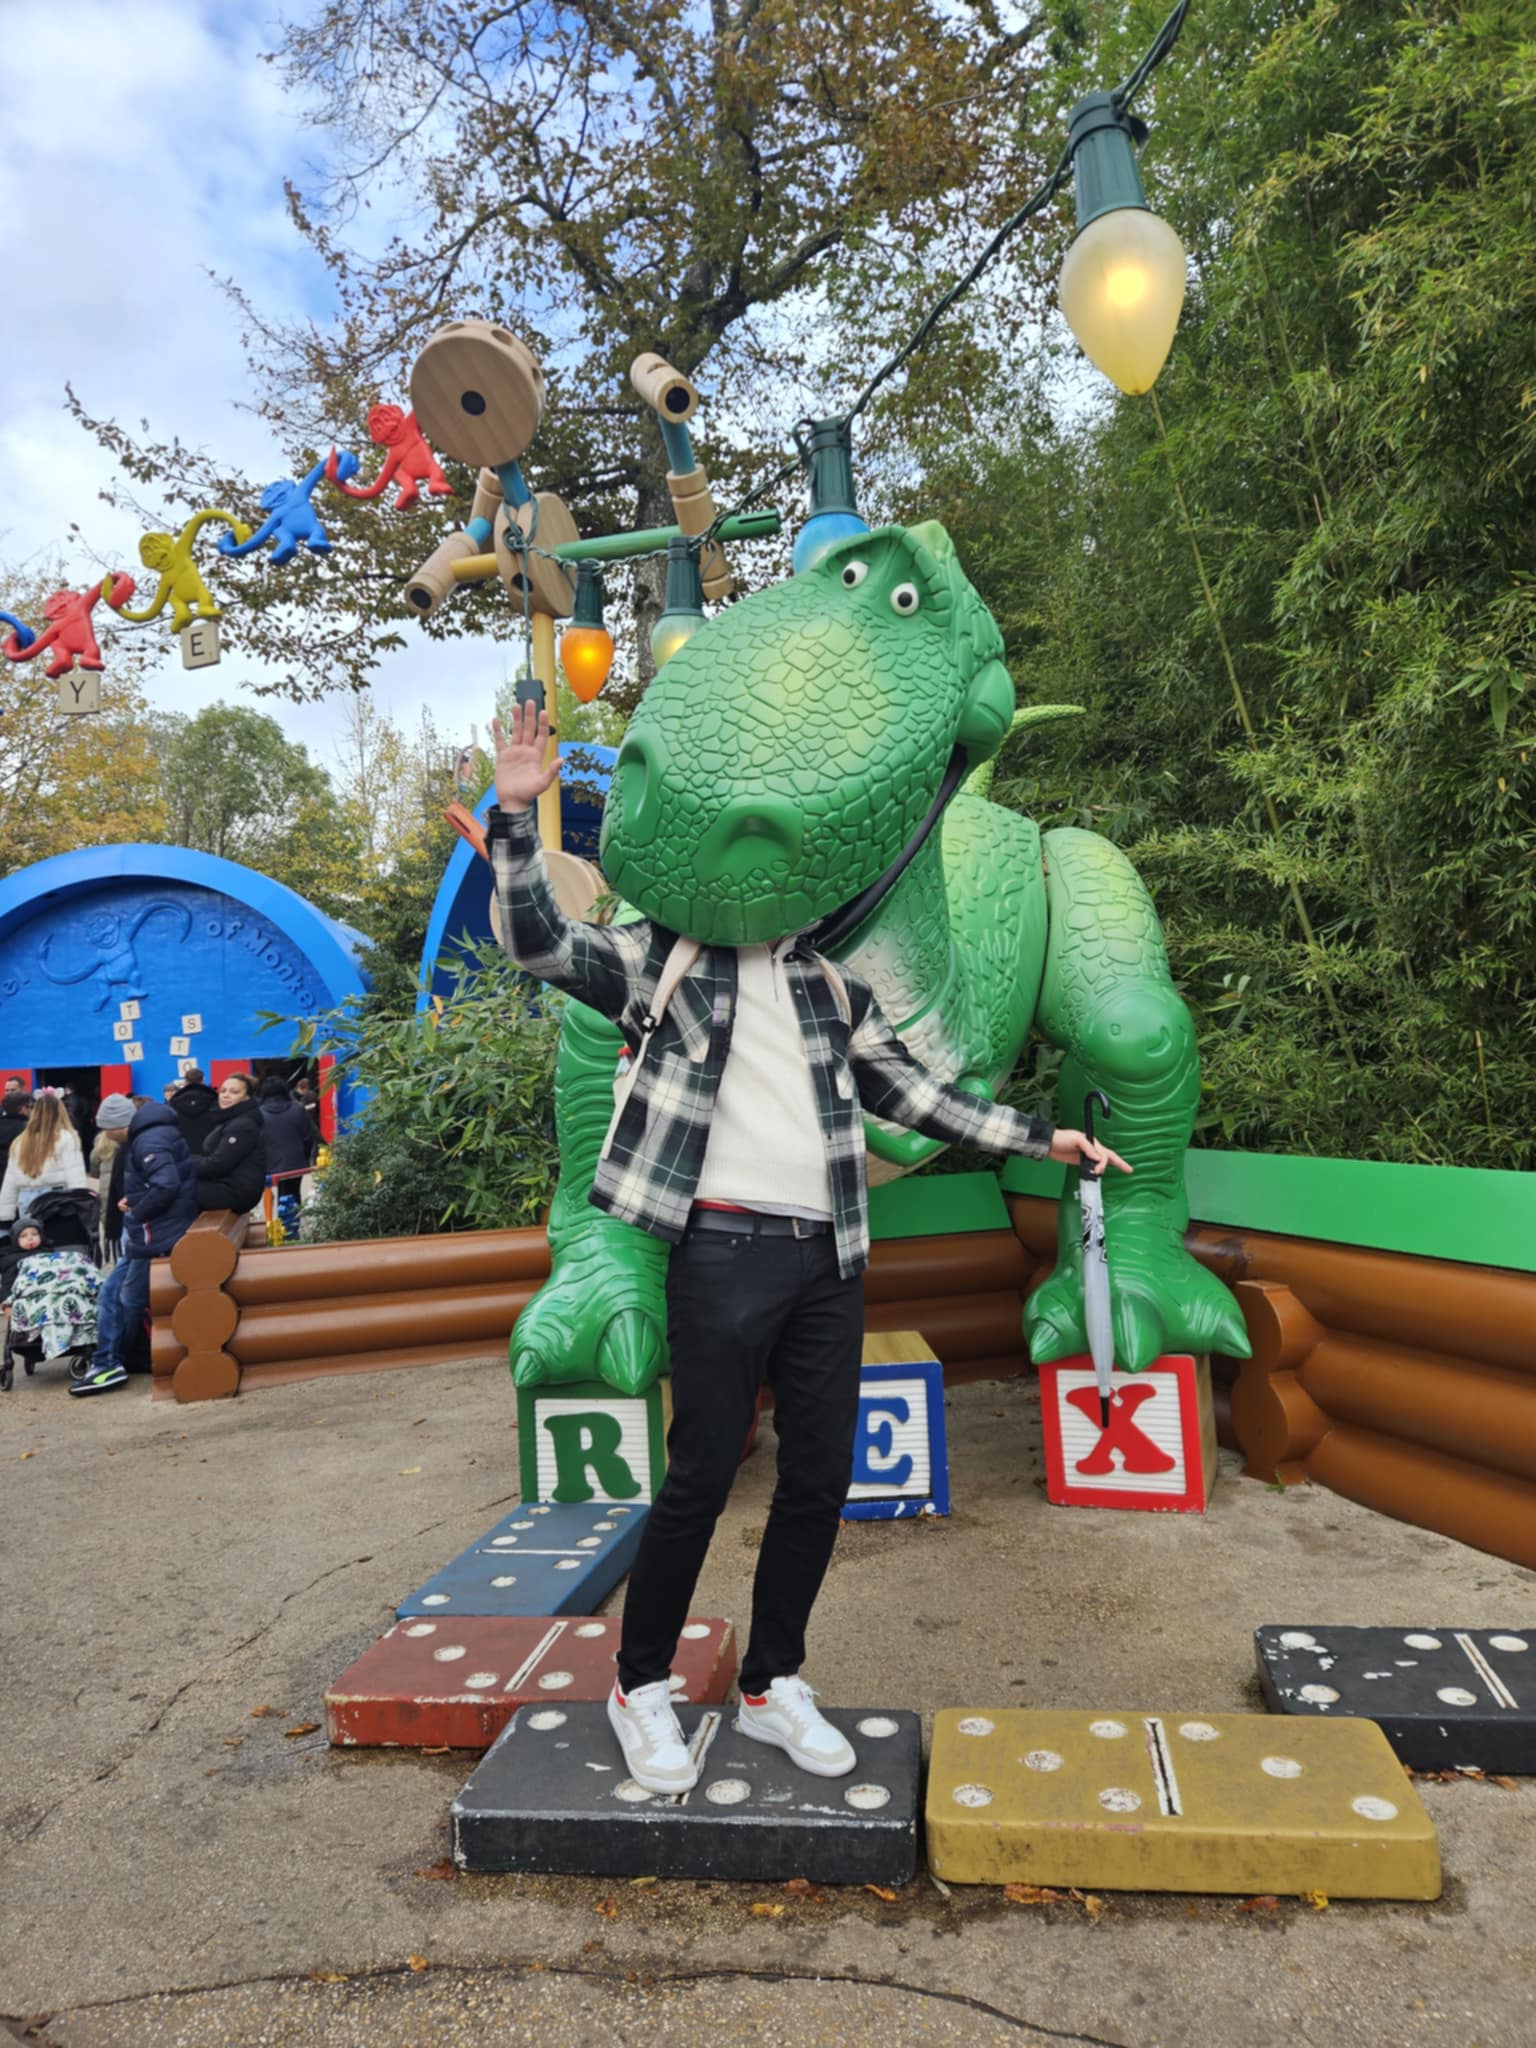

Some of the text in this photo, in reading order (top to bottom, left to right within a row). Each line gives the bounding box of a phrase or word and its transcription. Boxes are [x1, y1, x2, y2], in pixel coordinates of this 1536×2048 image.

[190, 632, 205, 657] E
[70, 679, 86, 704] Y
[207, 920, 244, 940] of
[543, 1412, 642, 1503] R
[852, 1397, 913, 1486] E
[1065, 1383, 1176, 1475] X
